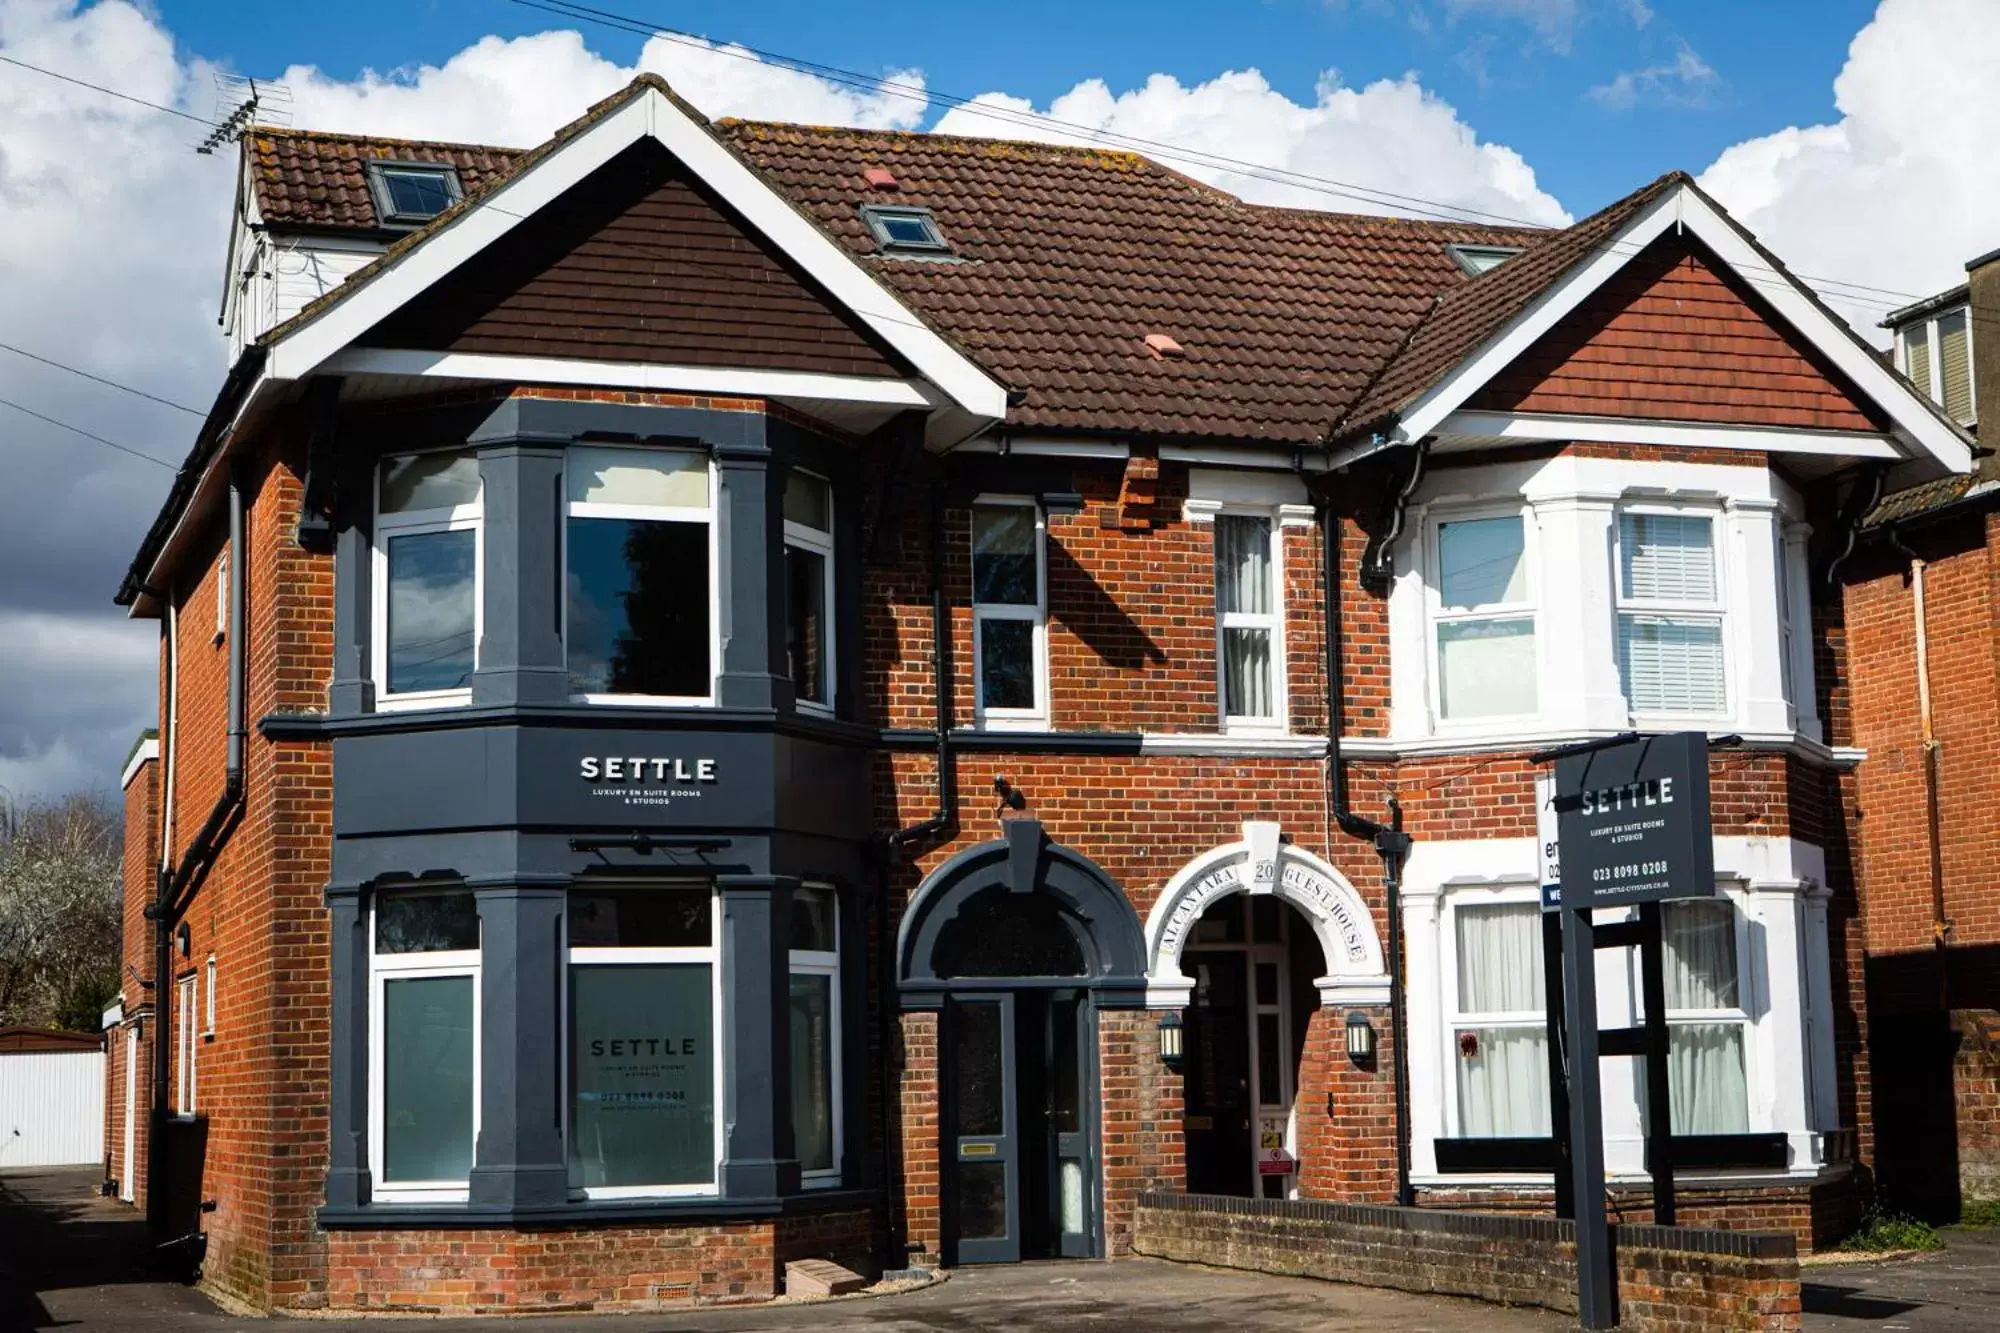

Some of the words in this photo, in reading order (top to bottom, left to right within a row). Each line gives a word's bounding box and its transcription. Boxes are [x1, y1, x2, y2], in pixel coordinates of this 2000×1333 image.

[580, 756, 716, 780] SETTLE
[592, 788, 627, 796] LUXURY
[1582, 777, 1673, 816] SETTLE
[1590, 827, 1613, 837] LUXURY
[1624, 823, 1641, 832] SUITE
[1642, 819, 1665, 829] ROOMS
[1617, 832, 1643, 843] STUDIOS
[1256, 864, 1274, 878] 20
[1593, 868, 1611, 881] 023
[1614, 864, 1638, 879] 8098
[1642, 860, 1668, 876] 0208
[1162, 867, 1235, 949] ALCANTARA
[1285, 867, 1332, 902] GUEST
[1331, 903, 1364, 957] HOUSE
[591, 1038, 695, 1056] SETTLE
